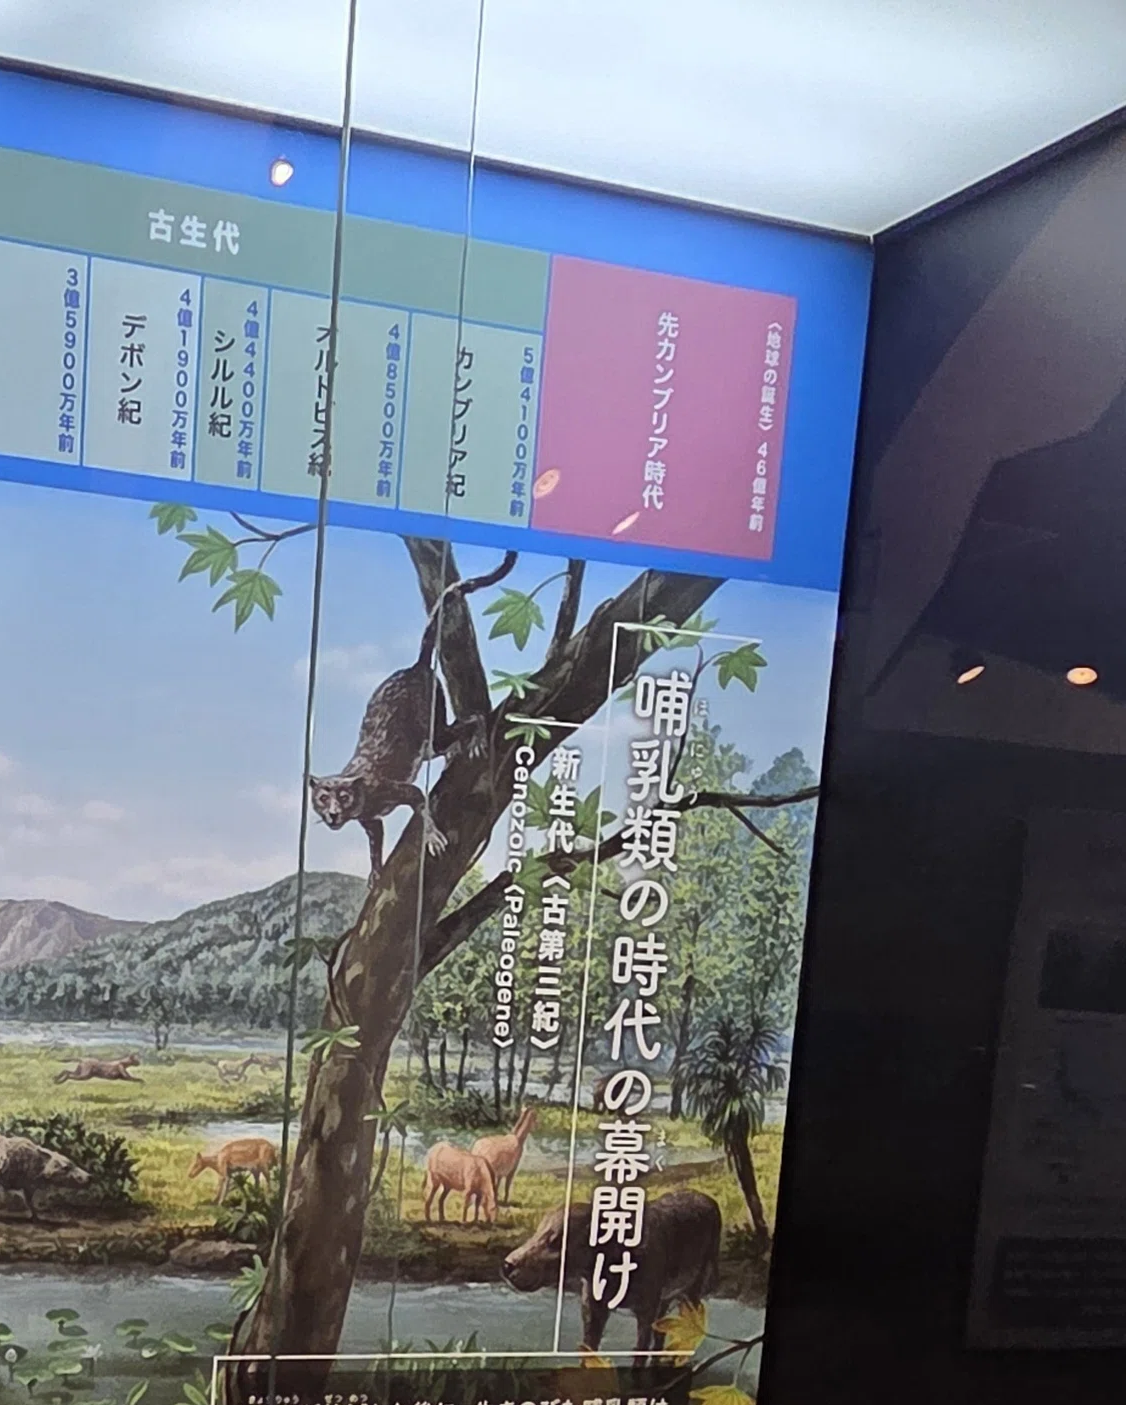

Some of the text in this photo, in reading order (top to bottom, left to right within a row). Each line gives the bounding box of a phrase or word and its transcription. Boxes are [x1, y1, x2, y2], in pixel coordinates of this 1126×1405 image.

[148, 208, 241, 255] 古生代
[58, 269, 80, 455] 3億5900万年前
[117, 314, 146, 426] デボン紀
[169, 288, 193, 470] 4億1900万年前
[207, 329, 236, 439] シルル紀
[236, 301, 260, 479] 4億4400万年前
[375, 322, 402, 500] 4億8500万年前
[508, 347, 537, 519] 5億4100万年前
[642, 311, 680, 512] 先カンブリア時代
[506, 745, 536, 874] Cenozoic
[589, 671, 694, 1310] 哺乳類の時代の幕開け
